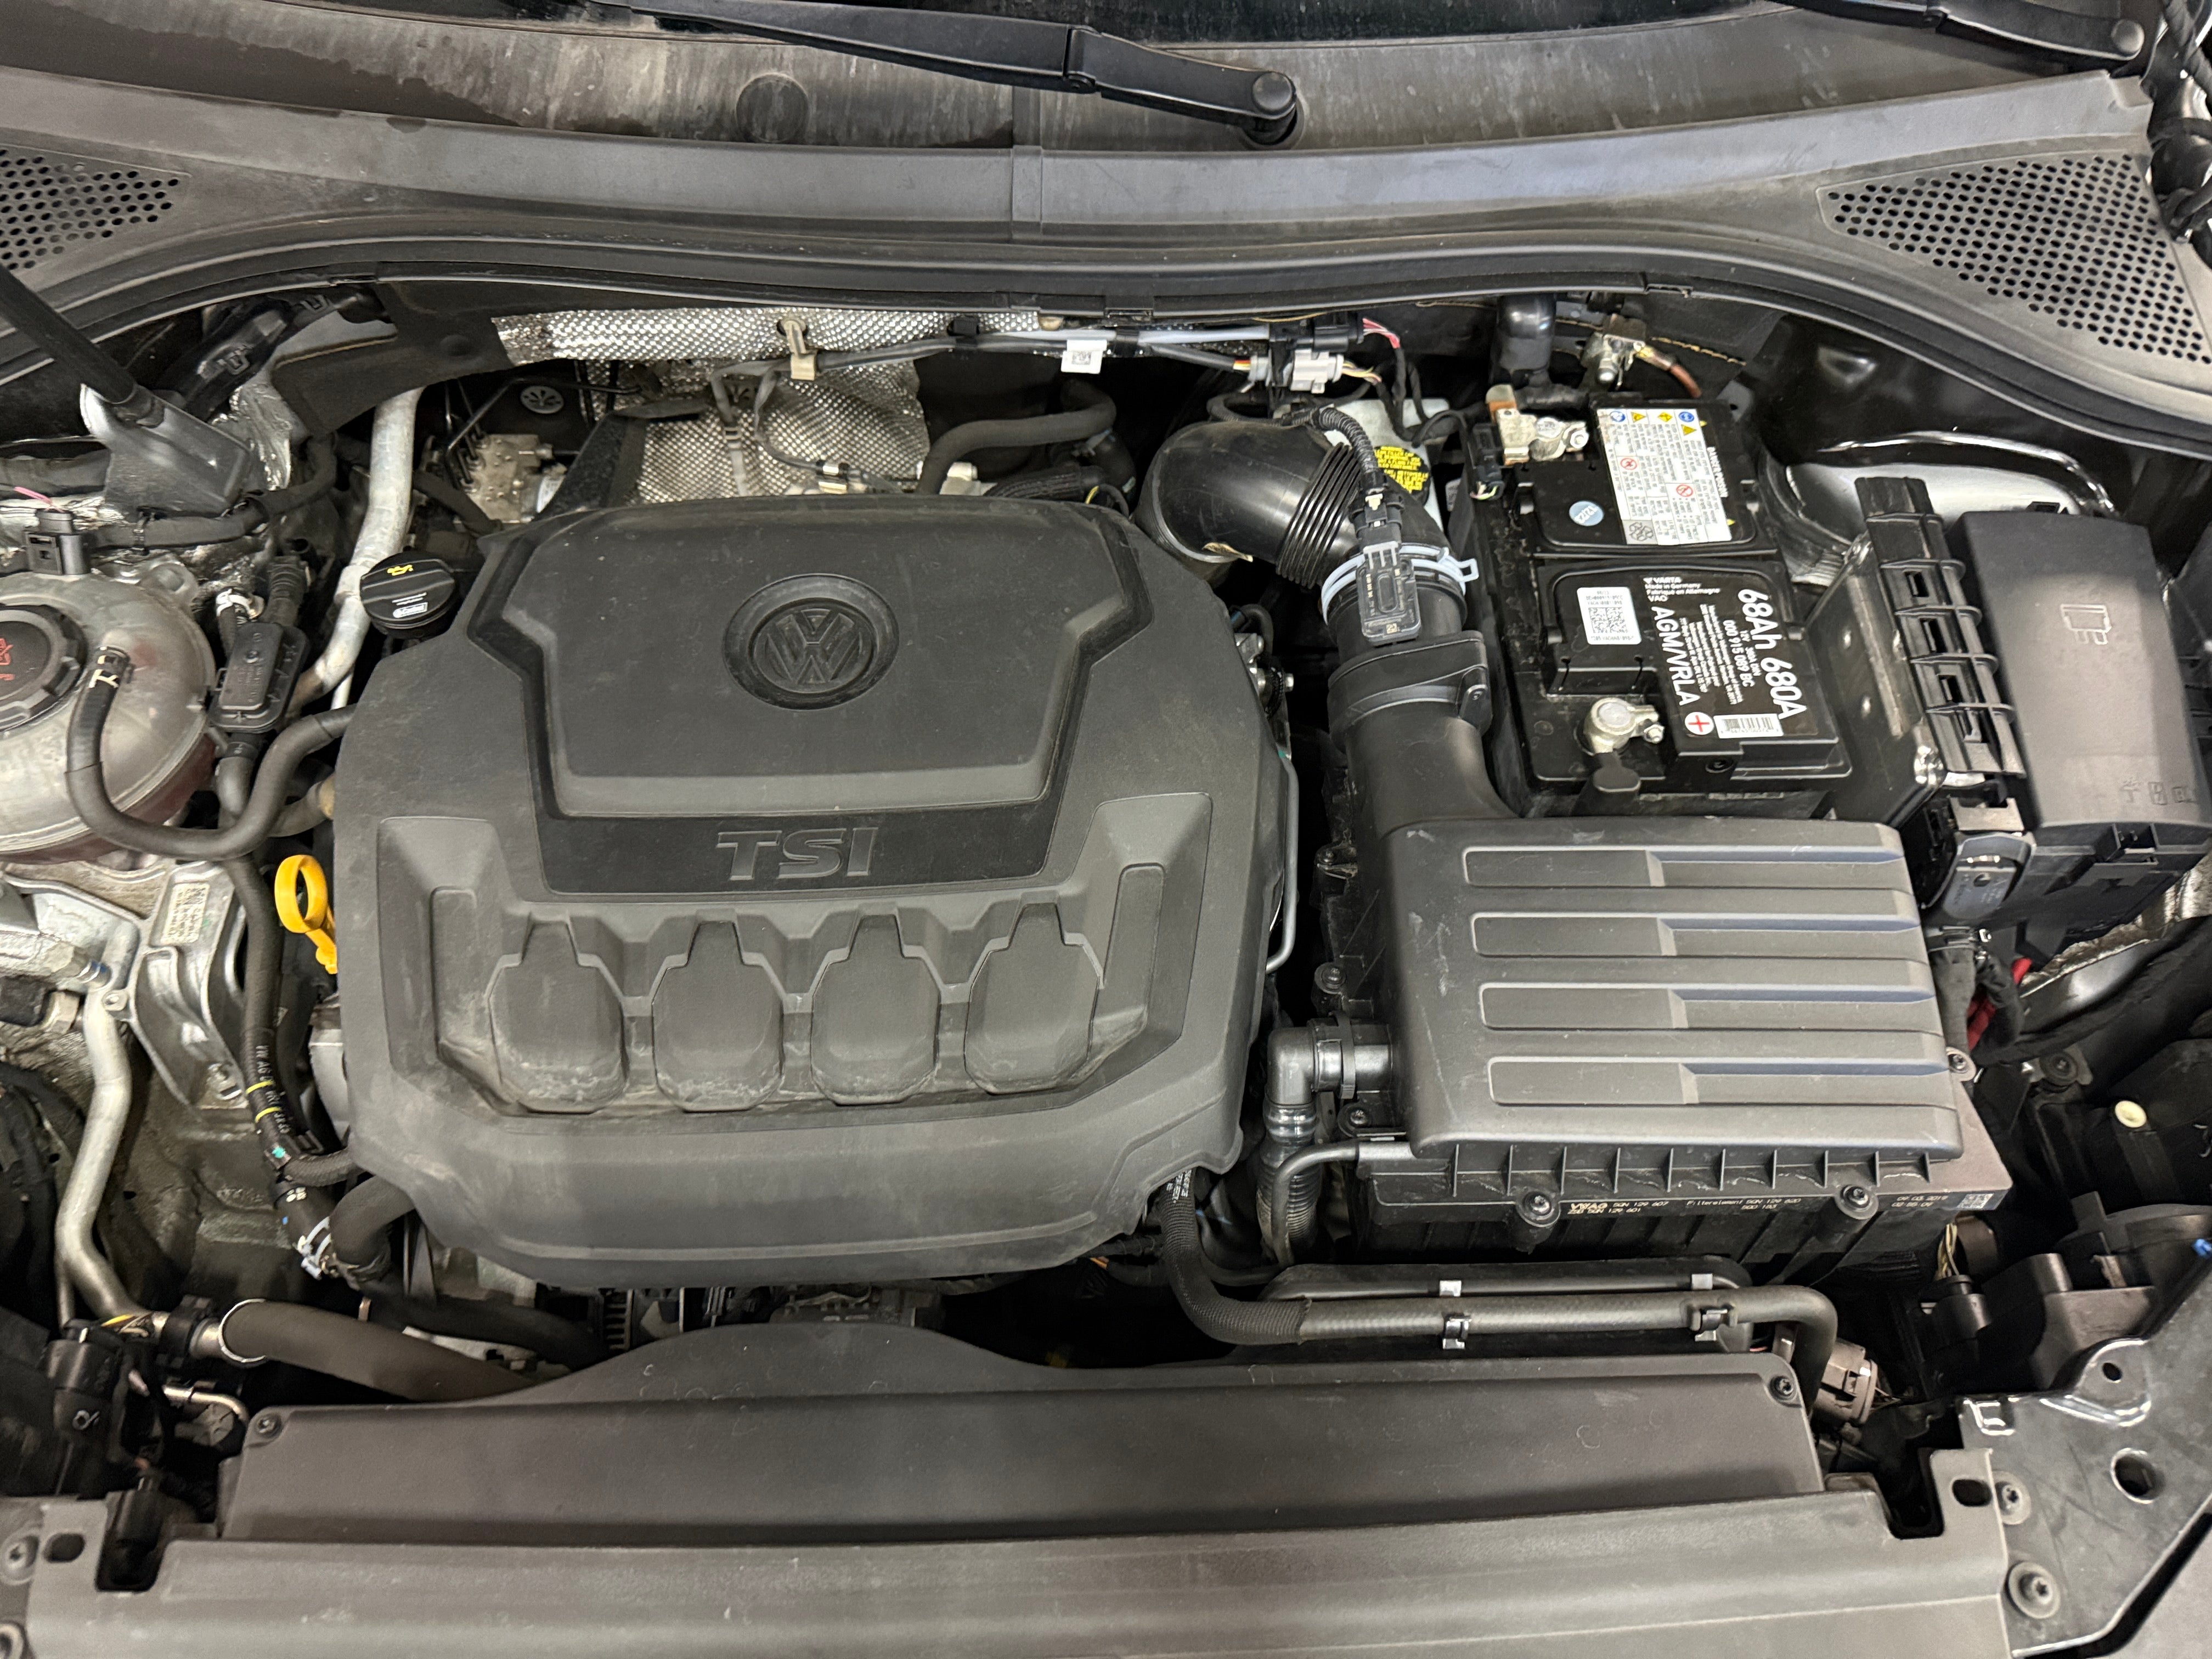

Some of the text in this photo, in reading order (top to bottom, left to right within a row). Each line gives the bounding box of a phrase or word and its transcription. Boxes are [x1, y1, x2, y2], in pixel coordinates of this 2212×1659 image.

[1723, 620, 1739, 636] 000
[1729, 637, 1745, 654] 915
[1738, 589, 1807, 719] 68Ah 680A
[1651, 606, 1701, 706] AGM/VRLA
[1734, 654, 1750, 672] 089
[1739, 673, 1755, 687] BC
[716, 827, 880, 881] TSI
